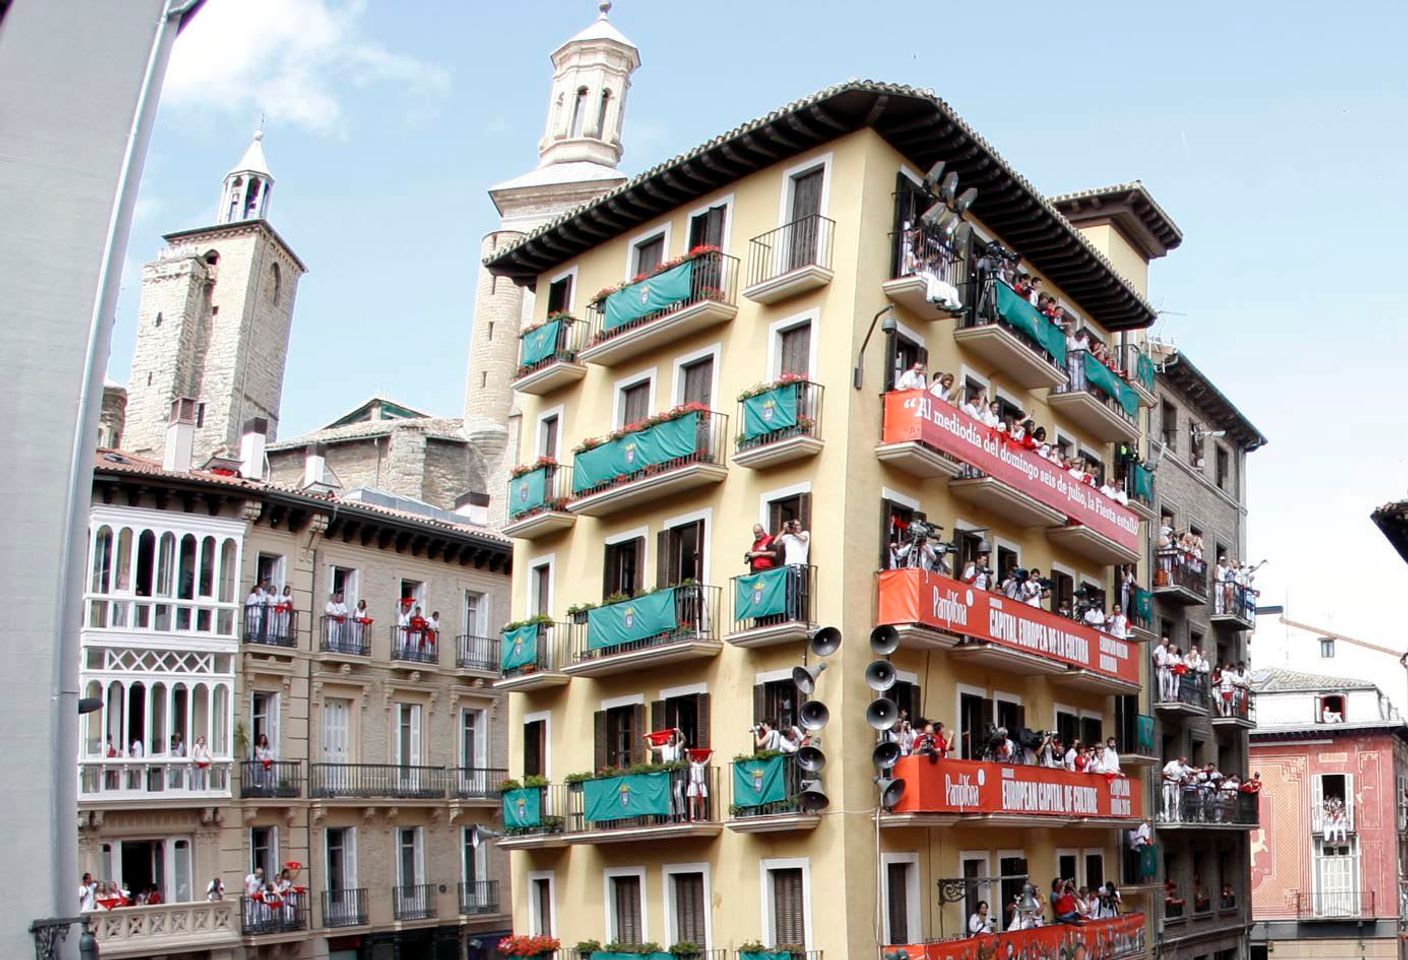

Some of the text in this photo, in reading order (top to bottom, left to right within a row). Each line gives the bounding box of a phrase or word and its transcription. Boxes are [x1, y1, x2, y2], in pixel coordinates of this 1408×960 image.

[934, 410, 981, 449] mediodía
[984, 432, 999, 458] del
[1000, 442, 1039, 480] domingo
[1040, 469, 1057, 489] seis
[1057, 474, 1067, 495] de
[1088, 491, 1095, 511] la
[1096, 497, 1117, 523] Fiesta
[989, 608, 1018, 643] CAPITAL
[1038, 781, 1065, 812] CAPITAL
[1064, 784, 1073, 813] OF
